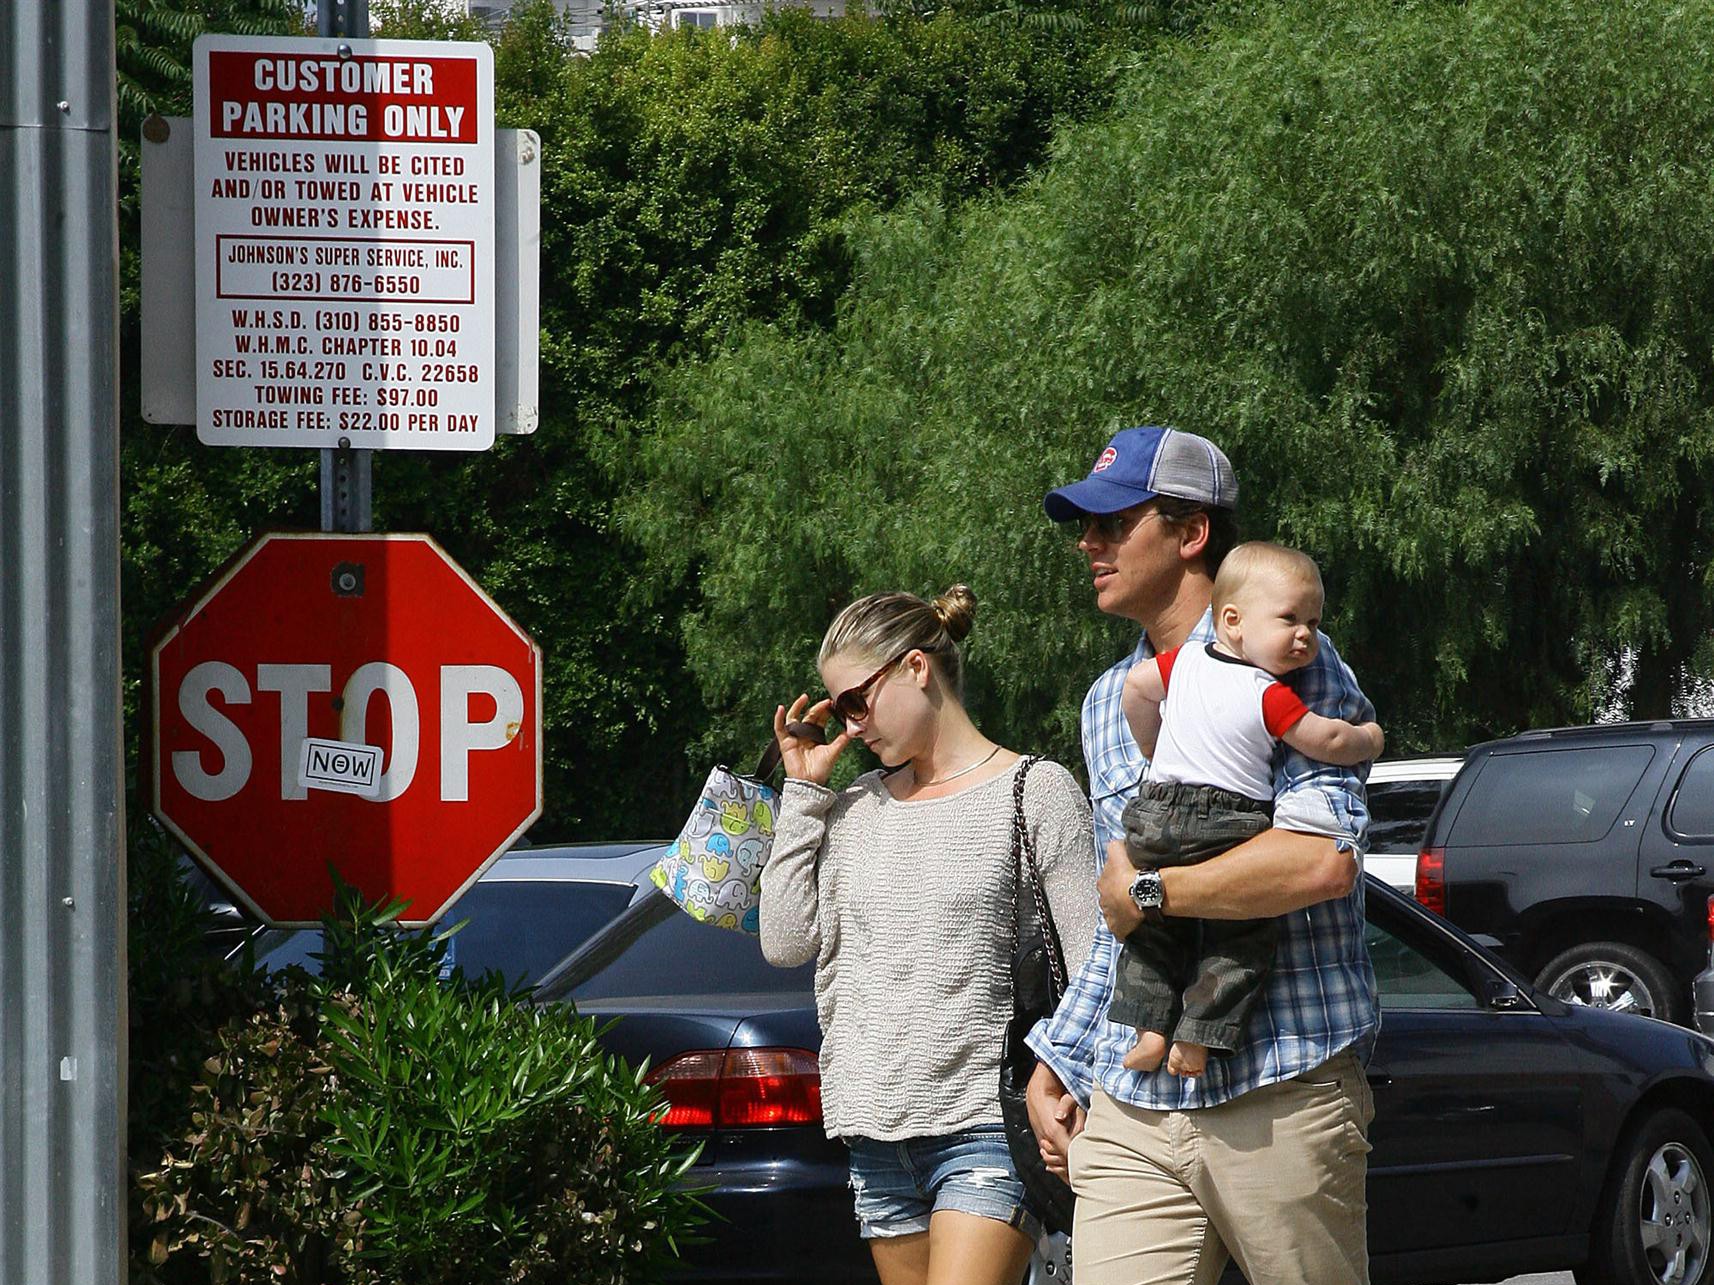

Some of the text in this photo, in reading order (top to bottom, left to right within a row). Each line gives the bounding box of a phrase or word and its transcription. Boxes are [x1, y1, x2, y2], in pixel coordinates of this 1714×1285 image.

[254, 58, 433, 94] CUSTOMER
[222, 101, 464, 138] PARKING ONLY
[225, 152, 464, 176] VEHICLES WILL BE CITED
[211, 179, 478, 203] AND/OR TOWED AT VEHICLE
[251, 207, 440, 230] OWNER'S EXPENSE.
[228, 245, 463, 270] JOHNSON'S SUPER SERVICE, INC.
[272, 271, 420, 293] (323) 876-6550
[232, 310, 460, 332] W.H.S.D. (310) 855-8850
[235, 335, 457, 357] W.H.M.C. CHAPTER 10.04
[213, 360, 479, 383] SEC. 15.64.270 C.V.C. 22658
[254, 386, 438, 407] TOWING FEE: $97.00
[213, 410, 479, 432] STORAGE FEE: $22.00 PER DAY
[172, 661, 524, 802] STOP
[312, 750, 371, 778] NOW
